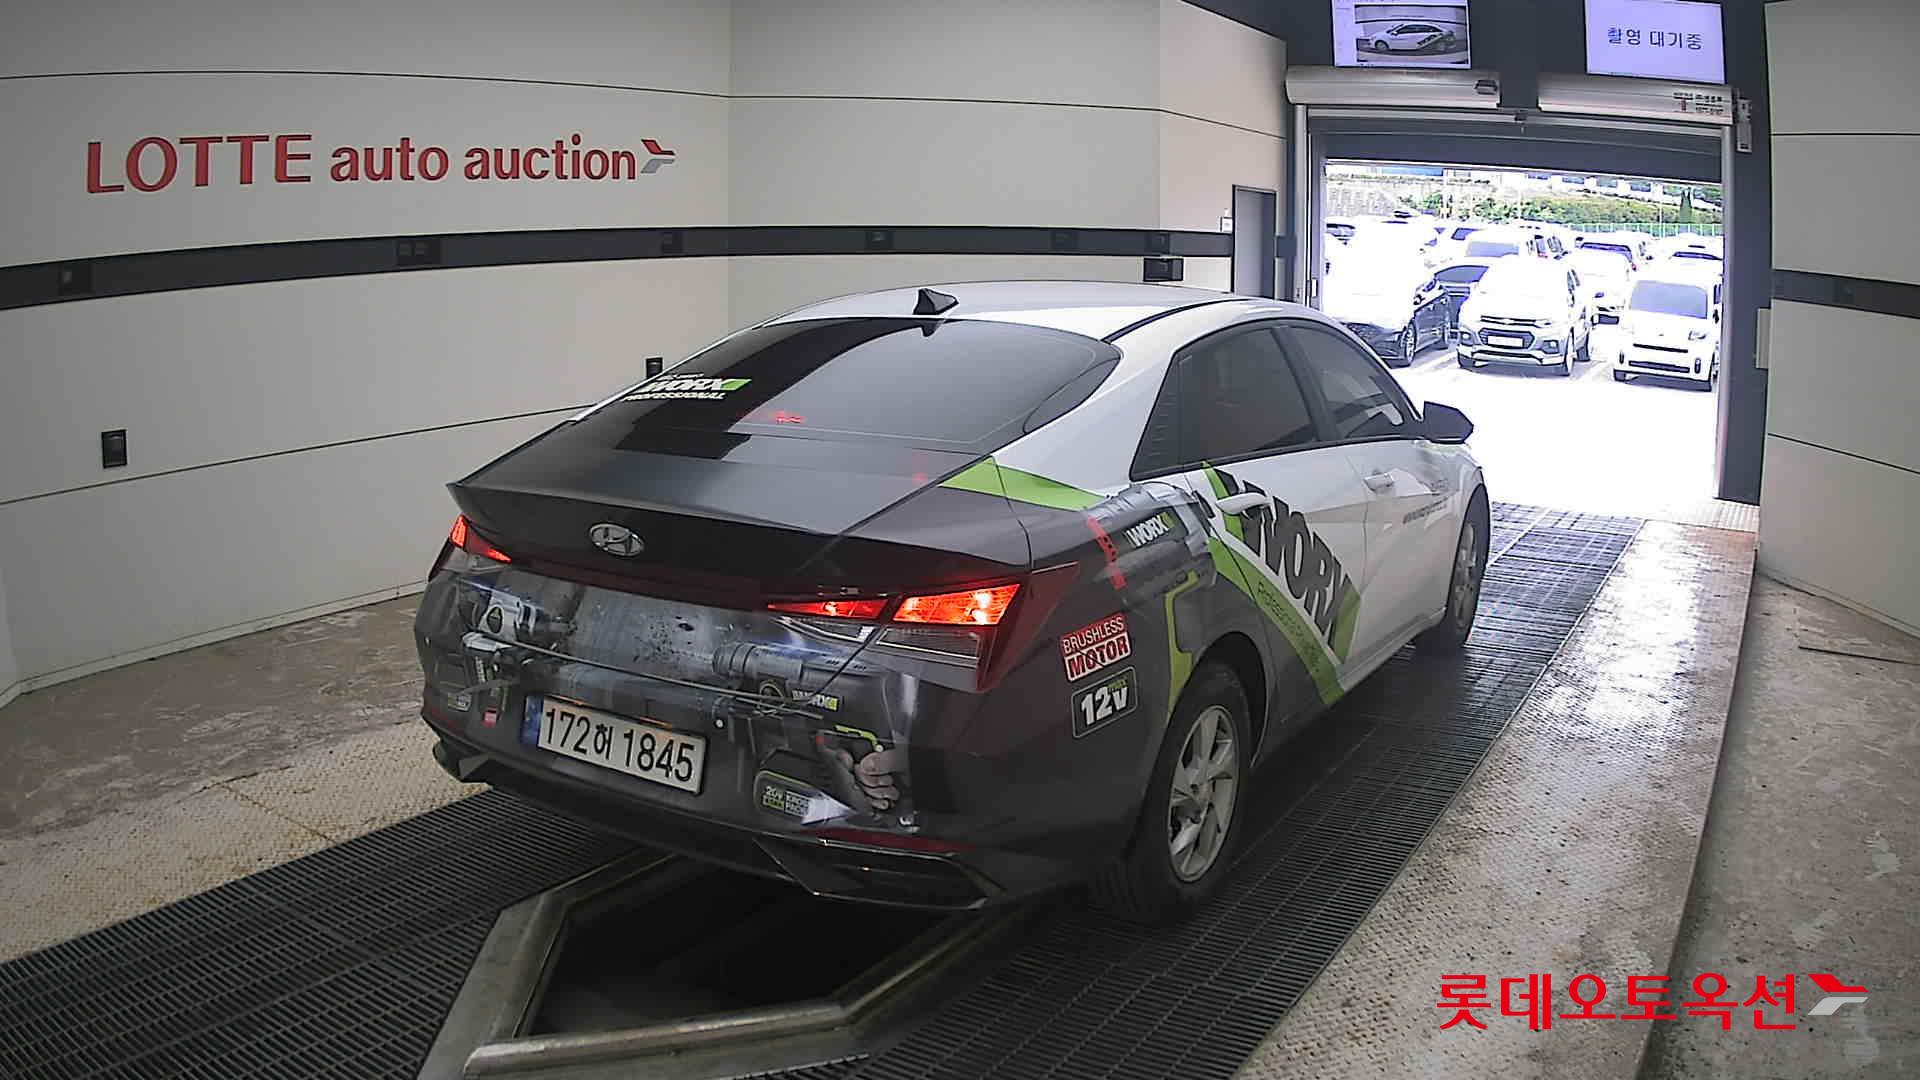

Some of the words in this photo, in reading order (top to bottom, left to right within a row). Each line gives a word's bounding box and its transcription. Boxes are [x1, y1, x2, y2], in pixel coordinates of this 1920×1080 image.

[1607, 27, 1641, 45] 촬영
[1649, 31, 1702, 50] 대기중
[86, 134, 312, 194] LOTTE
[330, 137, 451, 182] auto
[464, 133, 637, 181] auction
[1126, 511, 1177, 548] WORX
[1063, 616, 1125, 654] BRUSHLESS
[1068, 636, 1130, 679] MOTOR
[546, 707, 615, 761] 172허
[623, 728, 695, 783] 1845
